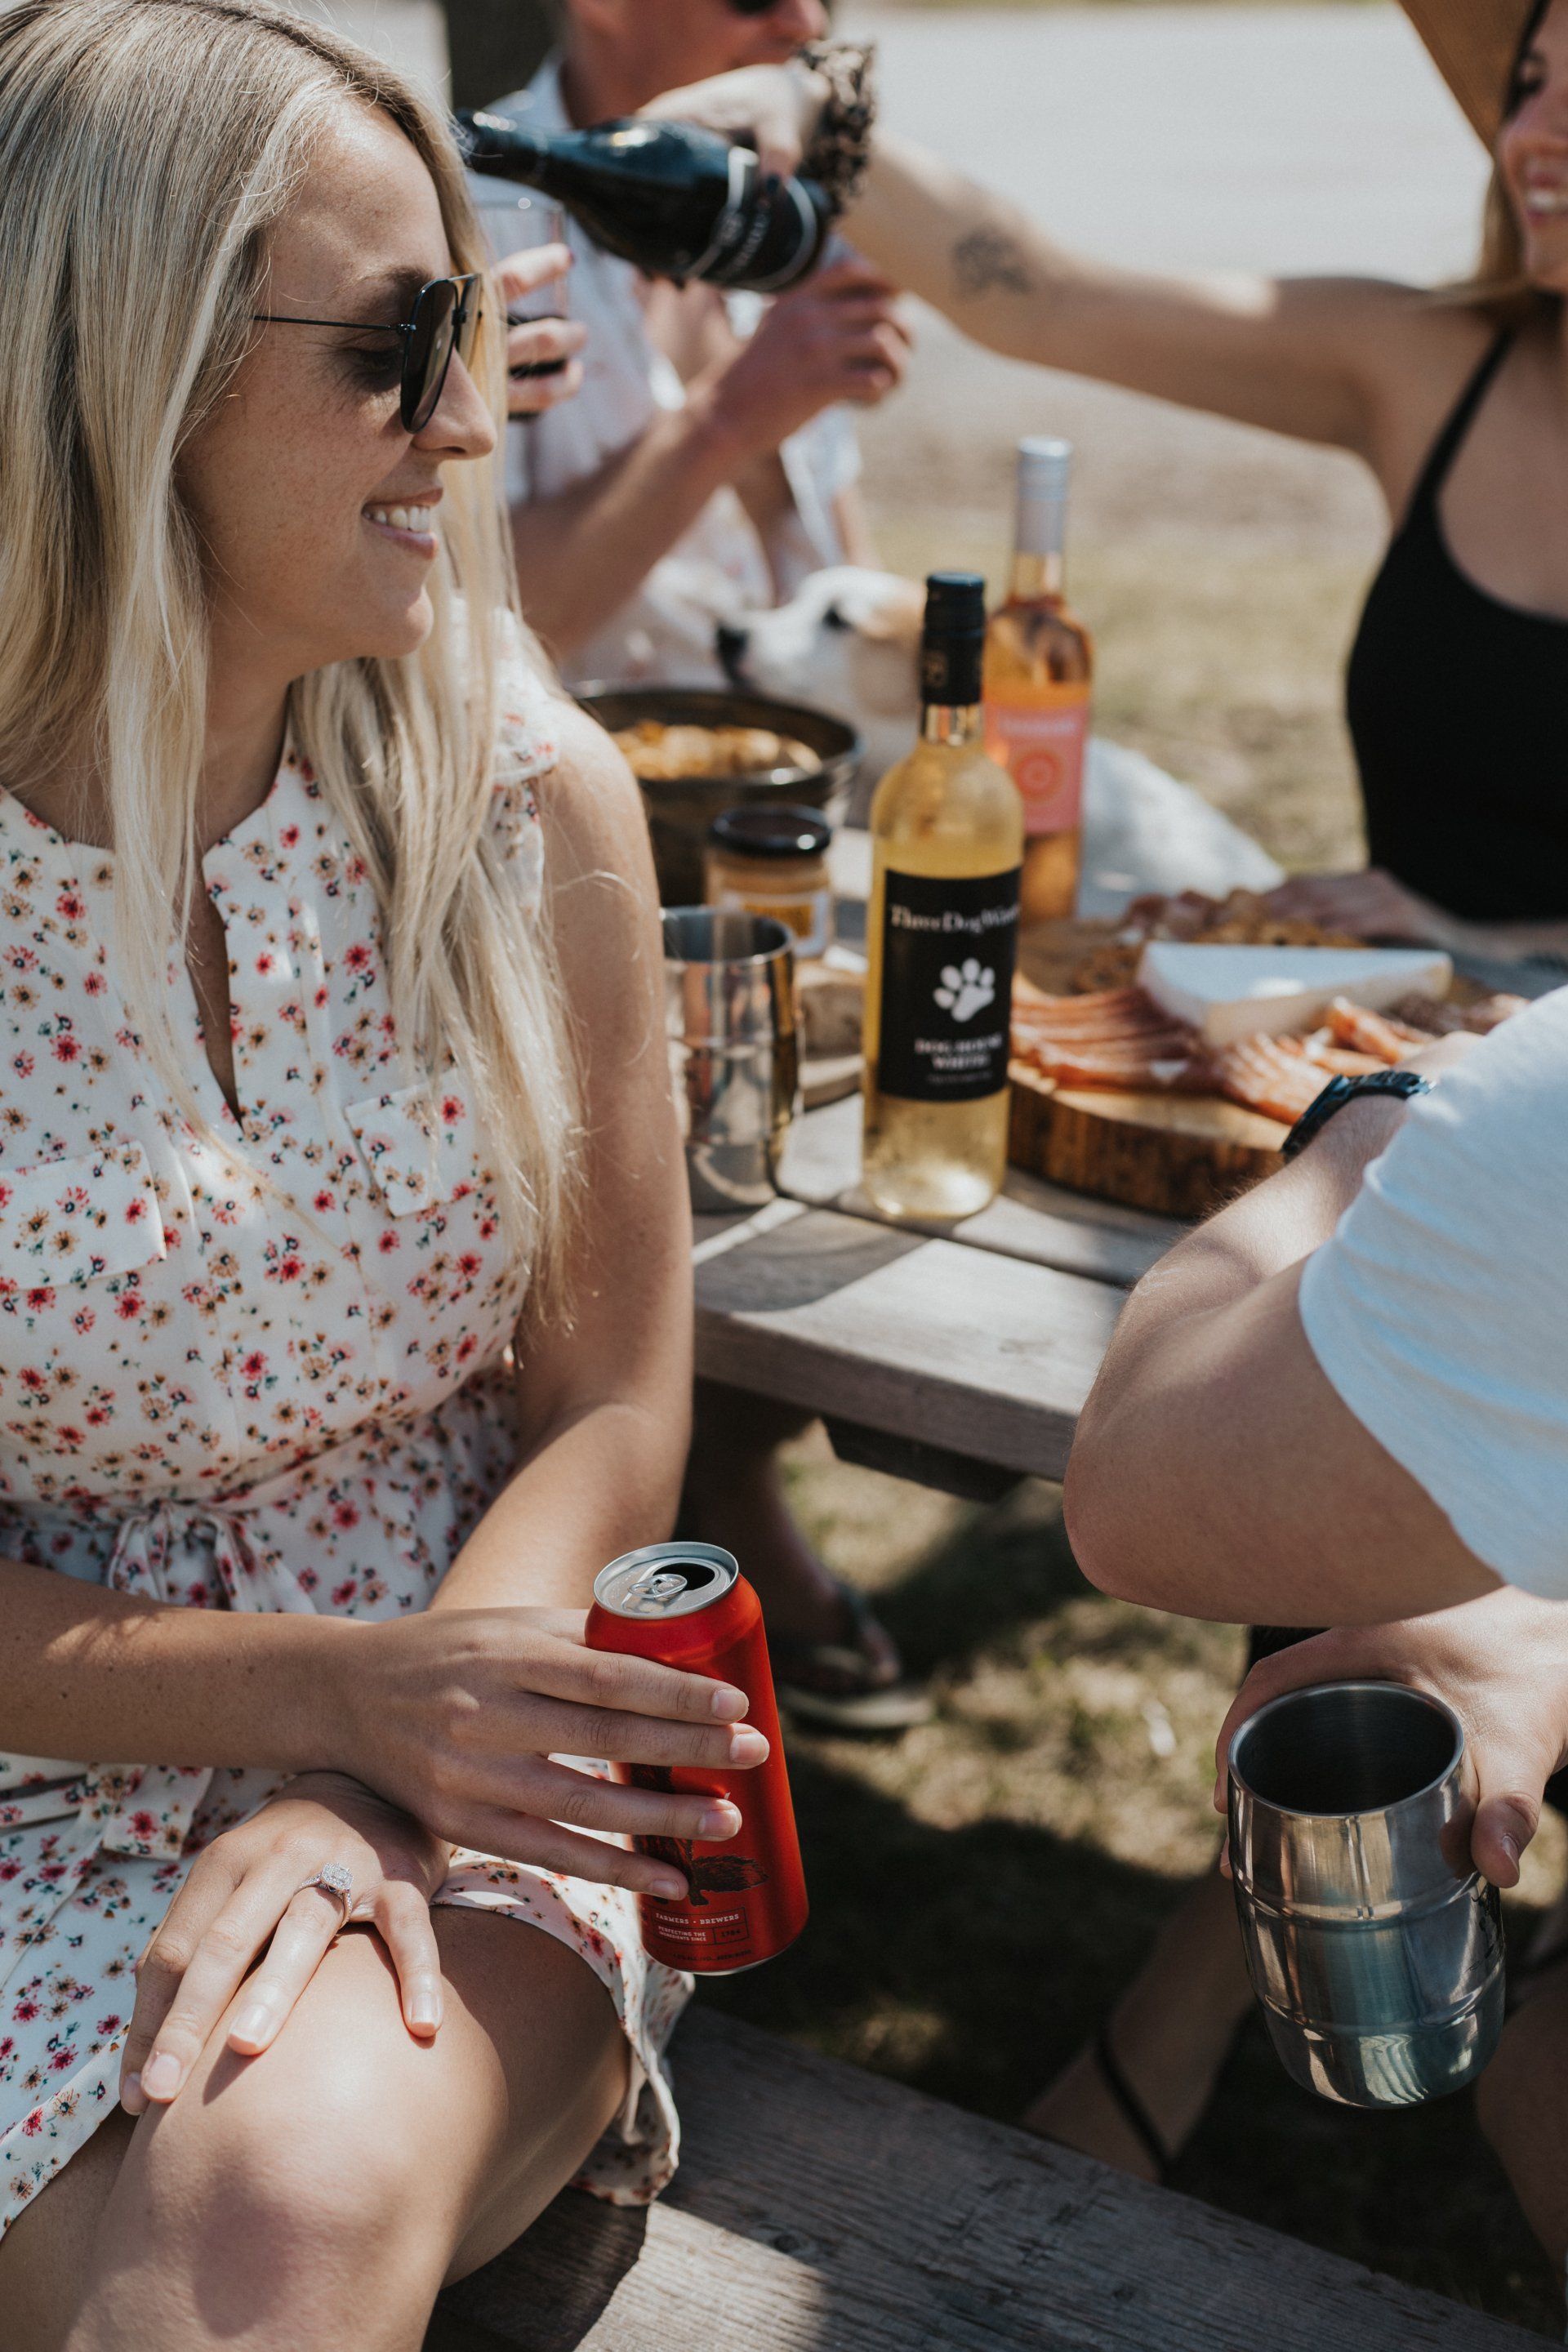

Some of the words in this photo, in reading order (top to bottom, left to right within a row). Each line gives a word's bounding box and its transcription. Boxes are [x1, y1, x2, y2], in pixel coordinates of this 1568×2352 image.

[656, 1913, 688, 1924] FARMERS
[700, 1913, 739, 1925] BREWERS
[658, 1926, 692, 1936] PERFECTING
